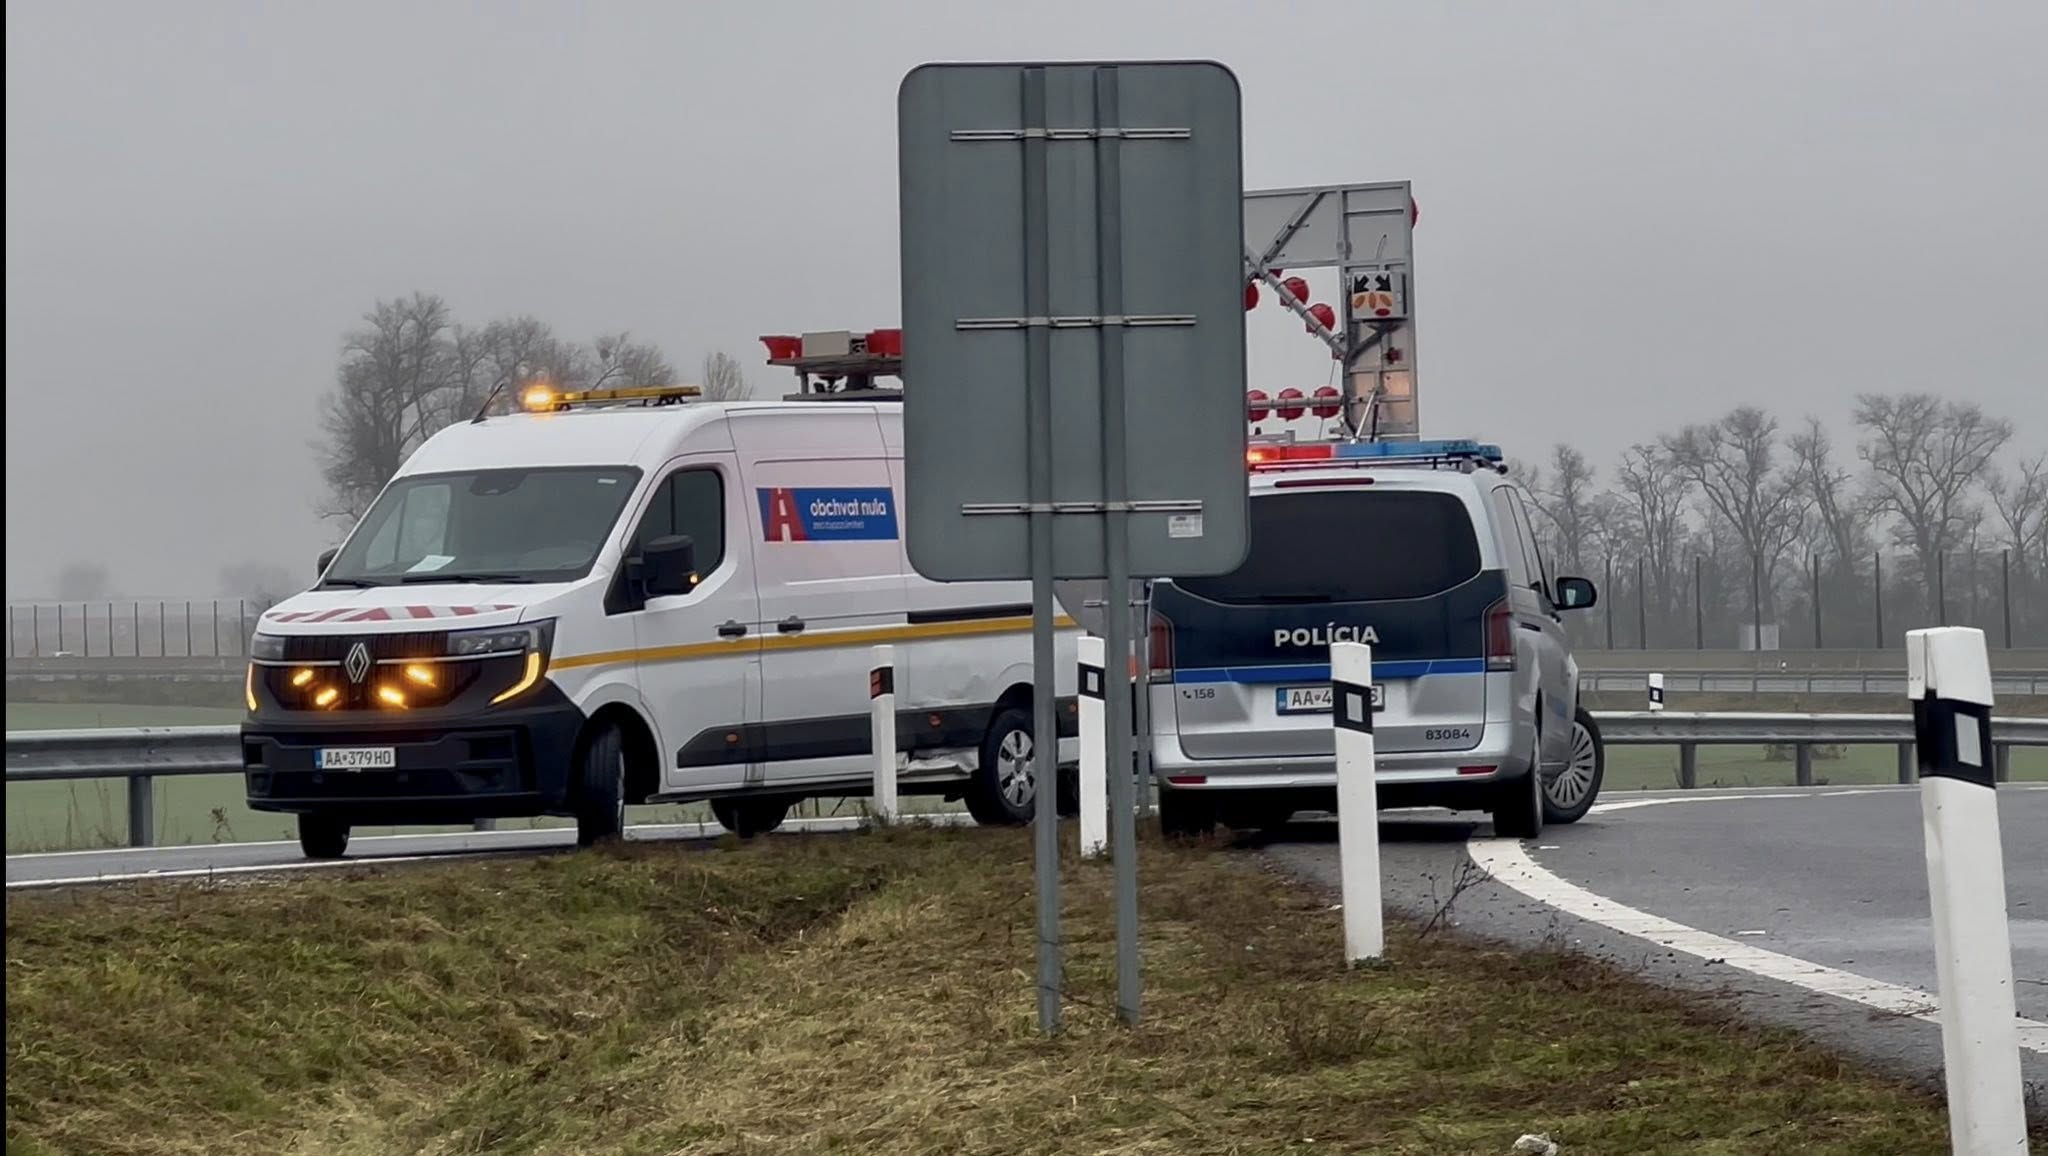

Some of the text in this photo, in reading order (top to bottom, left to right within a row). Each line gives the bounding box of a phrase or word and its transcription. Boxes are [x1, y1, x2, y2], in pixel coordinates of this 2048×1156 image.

[810, 498, 887, 516] obchvat nula
[1274, 621, 1380, 647] POLÍCIA
[1194, 688, 1216, 699] 158
[1425, 728, 1470, 740] 83084
